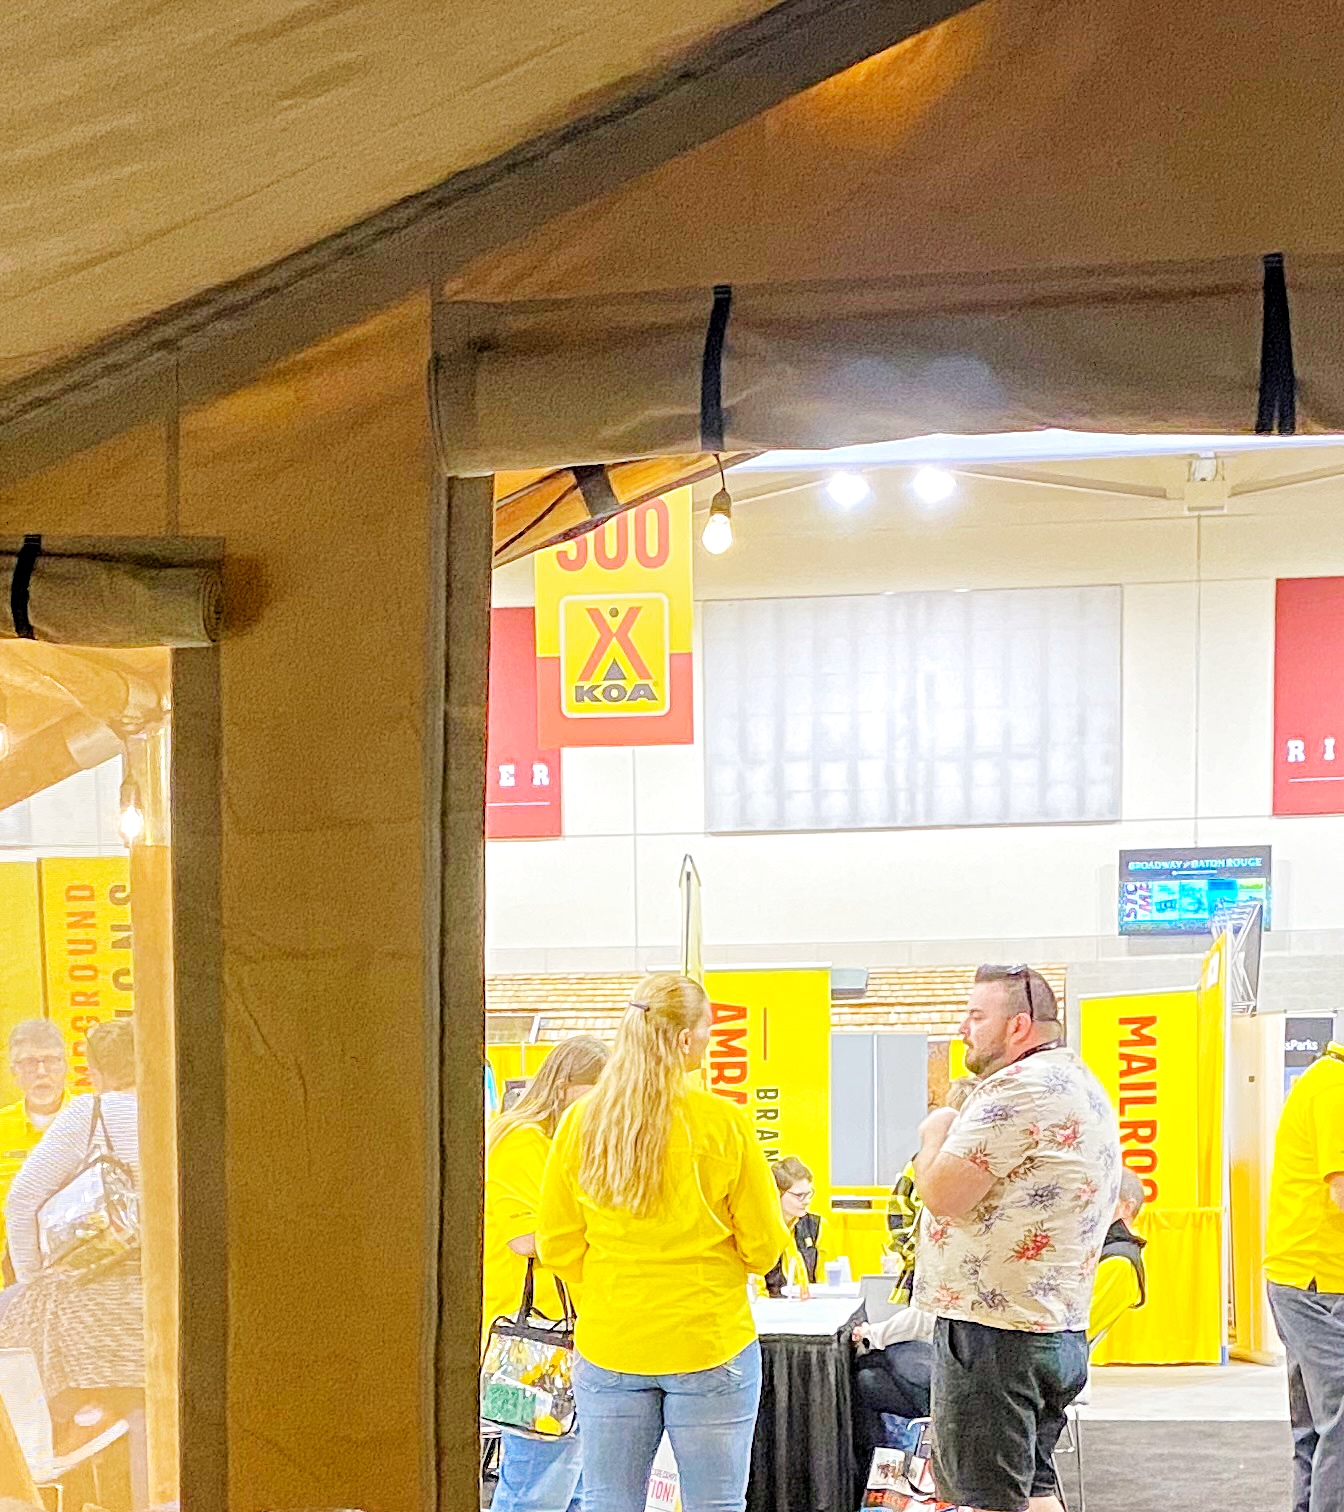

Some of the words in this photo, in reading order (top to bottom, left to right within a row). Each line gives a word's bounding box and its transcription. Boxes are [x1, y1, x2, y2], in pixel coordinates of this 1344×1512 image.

[574, 683, 659, 703] KOA
[1128, 861, 1183, 871] BROADWAY
[1191, 859, 1225, 869] BATON
[1226, 857, 1263, 867] ROUGE
